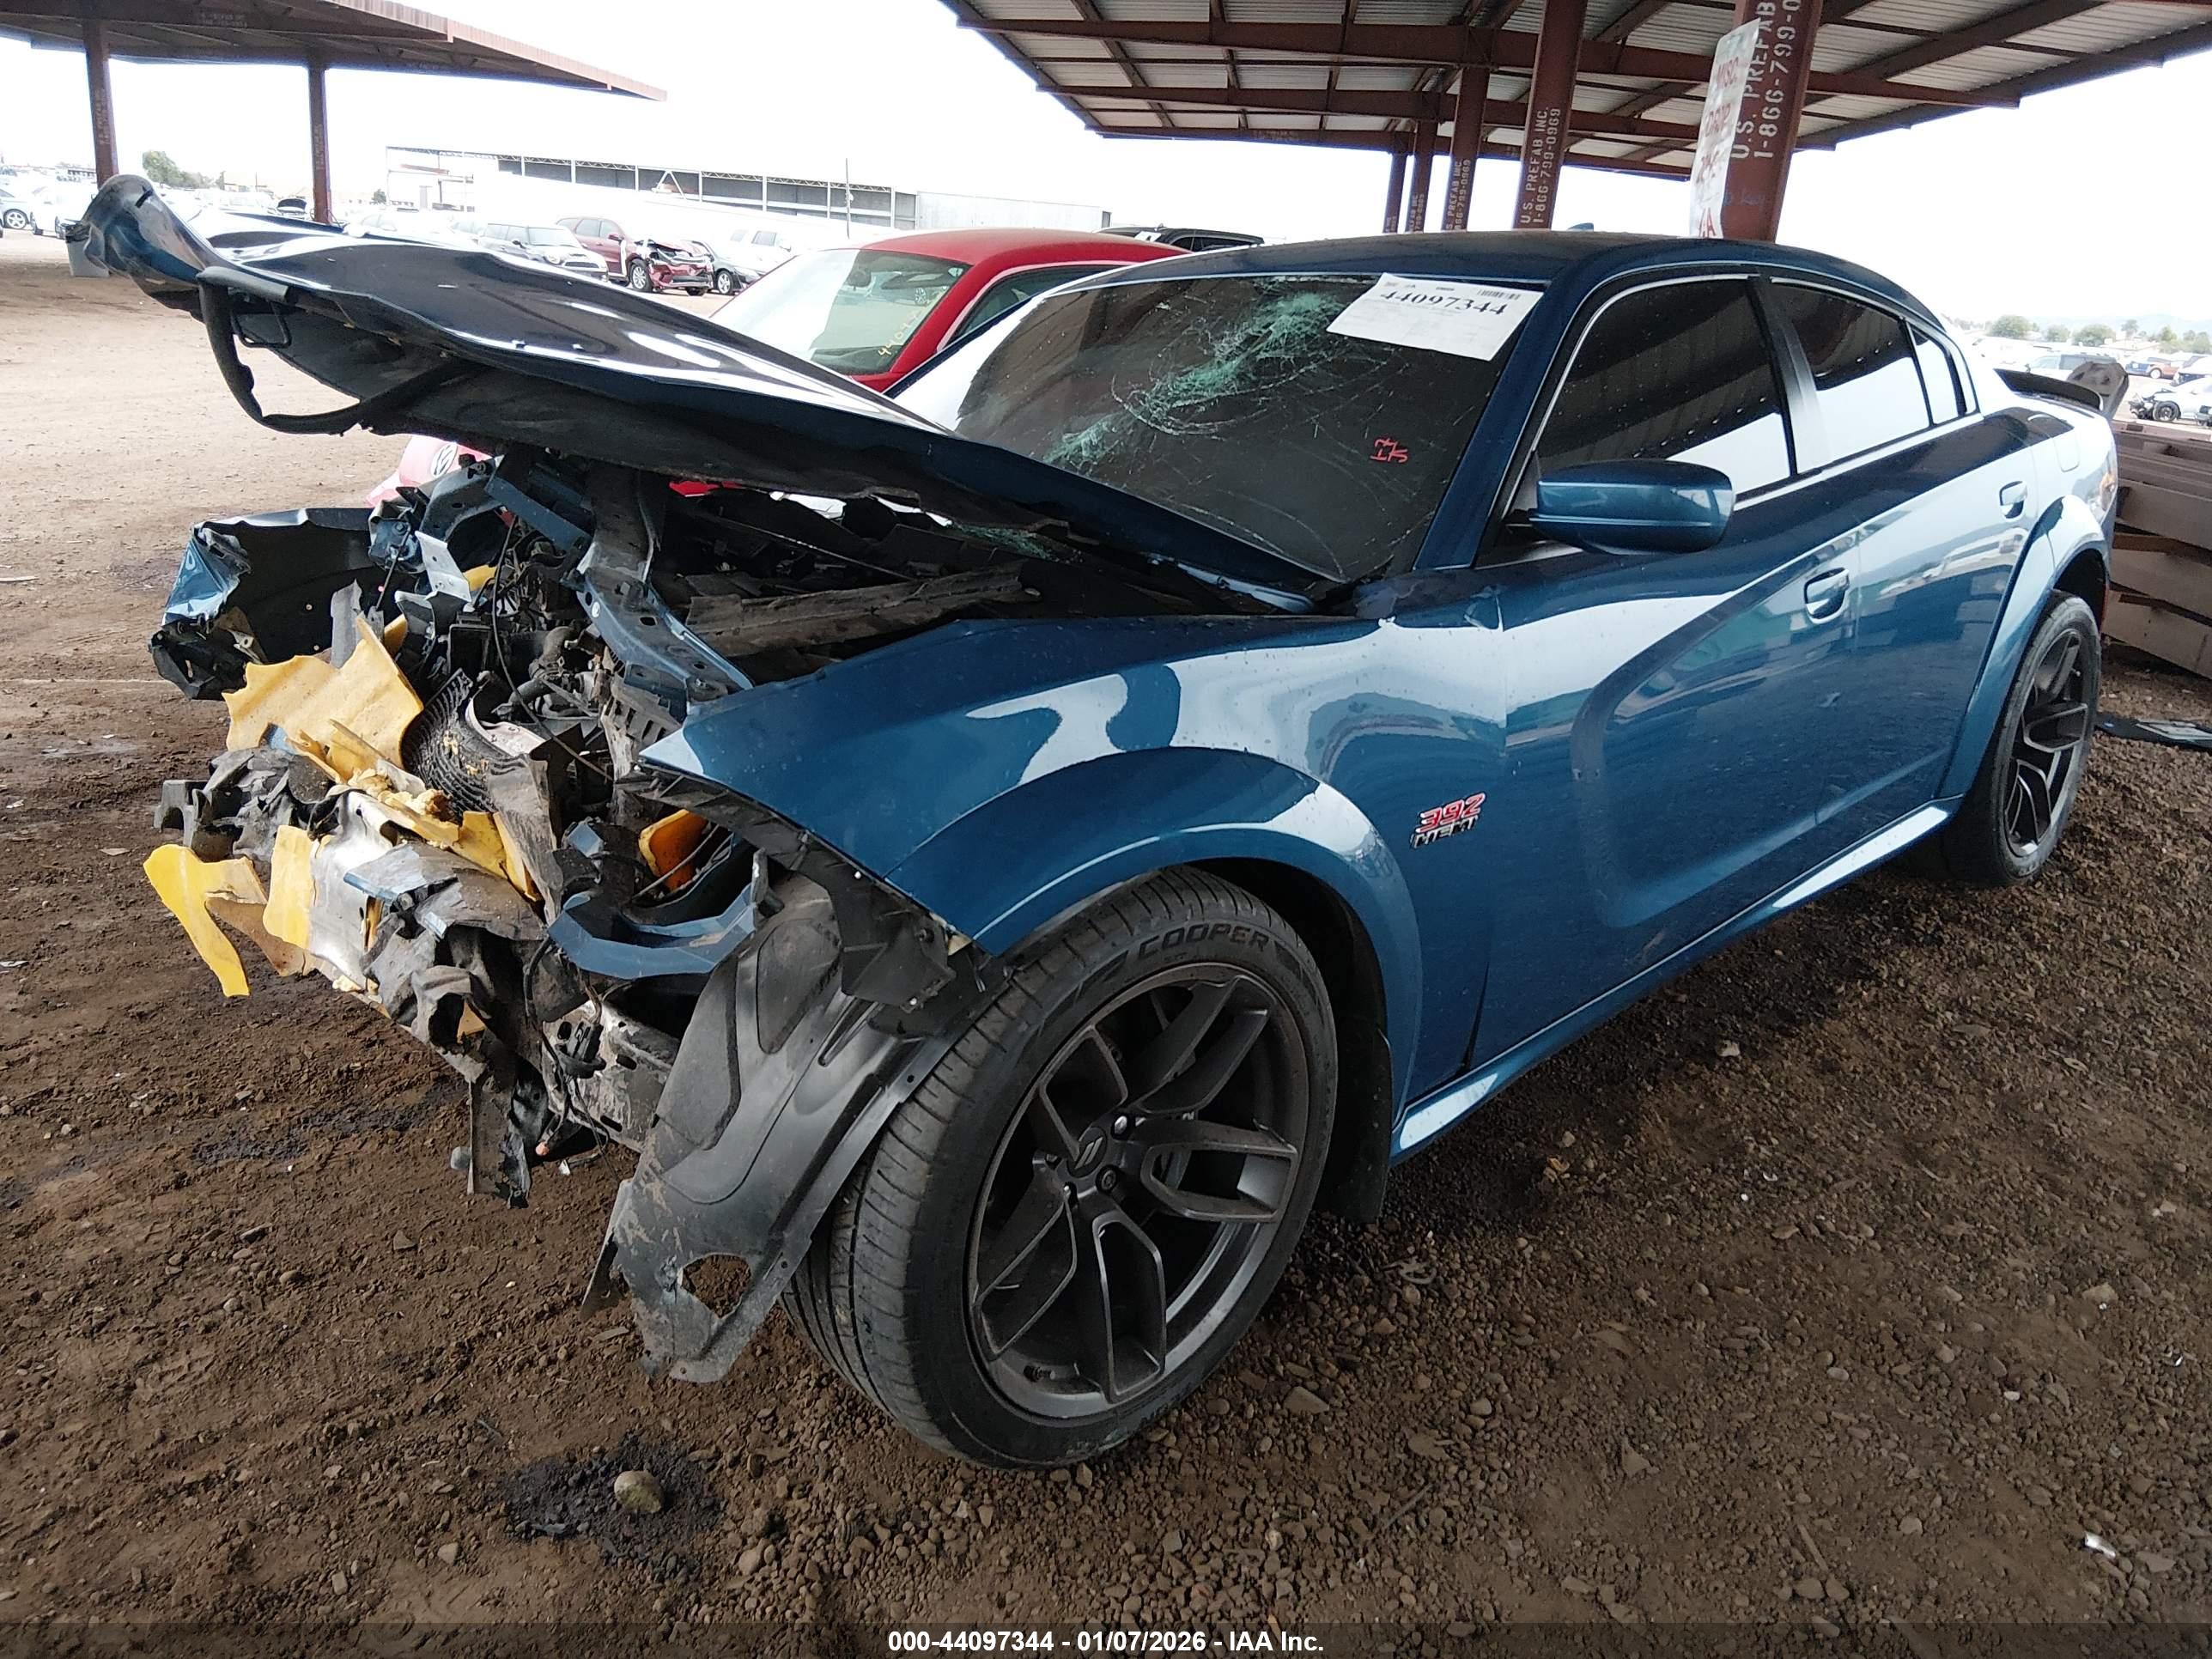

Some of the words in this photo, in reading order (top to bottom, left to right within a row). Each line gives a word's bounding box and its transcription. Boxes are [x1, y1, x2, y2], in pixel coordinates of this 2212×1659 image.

[1535, 106, 1549, 132] INC.
[1525, 139, 1543, 191] PREFAB
[1533, 108, 1560, 223] 1-866-799-0969
[1520, 198, 1534, 224] U.S.
[1380, 290, 1508, 315] 44097344
[1415, 792, 1486, 834] 392
[1139, 922, 1270, 959] COOPER
